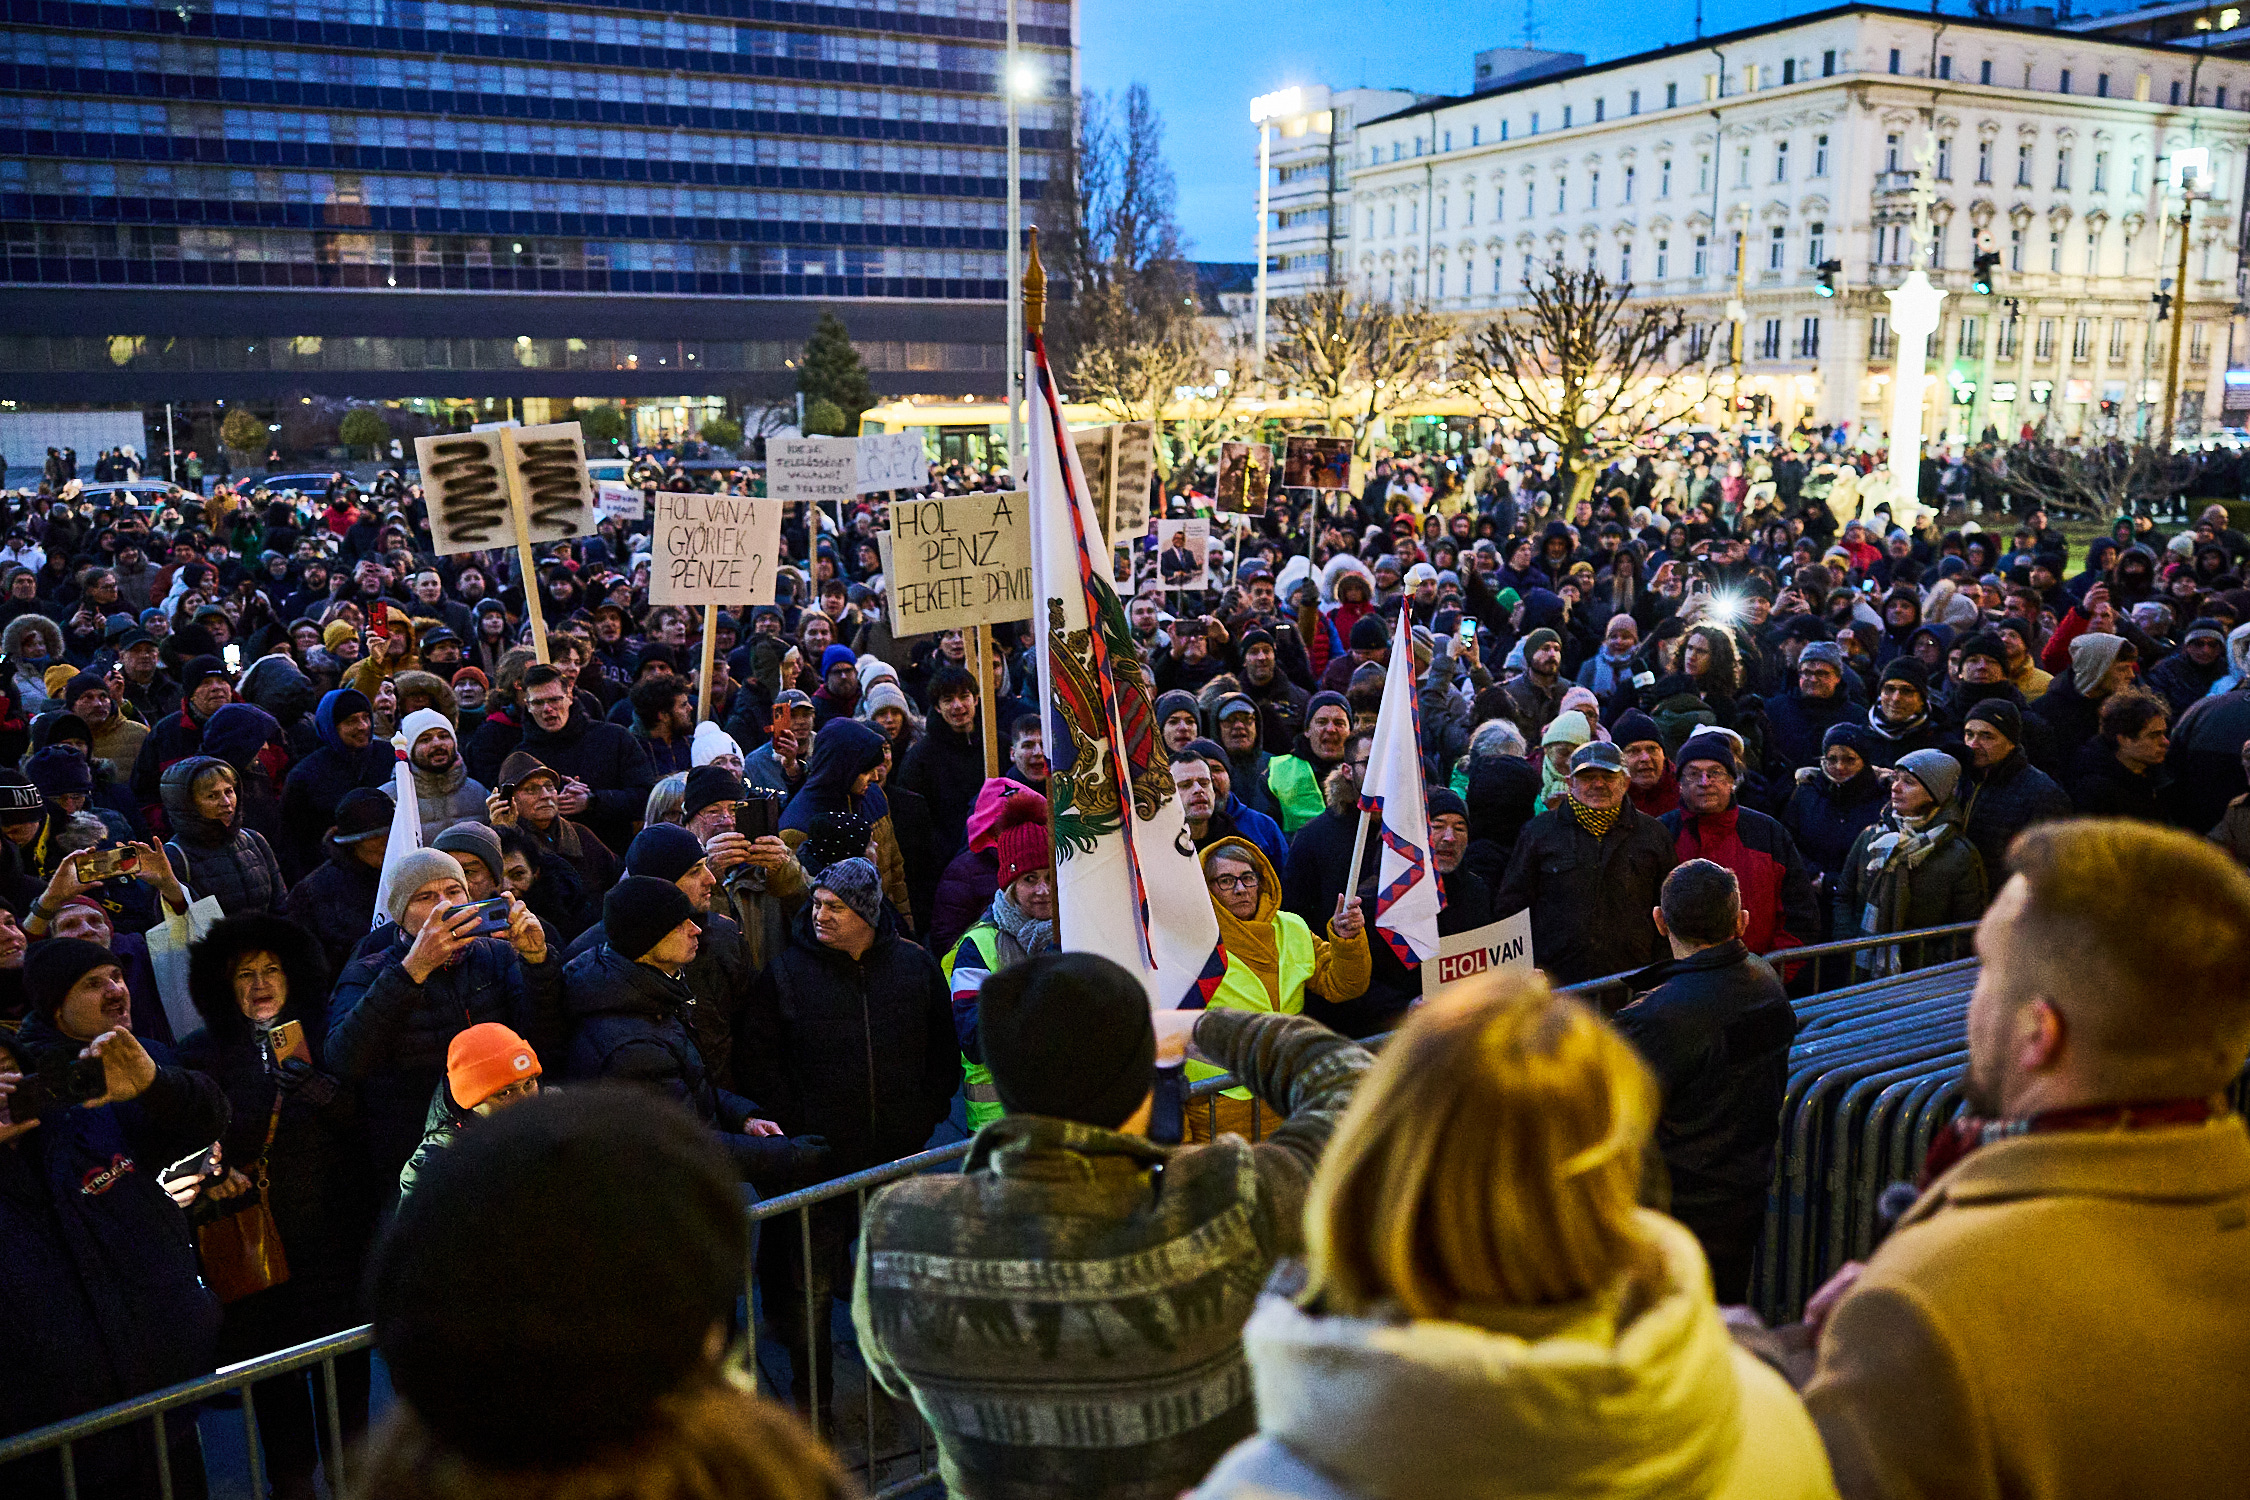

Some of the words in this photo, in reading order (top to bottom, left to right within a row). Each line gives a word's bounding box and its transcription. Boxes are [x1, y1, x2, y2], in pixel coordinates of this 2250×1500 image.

[659, 496, 698, 520] HOL
[705, 499, 740, 524] VAN
[741, 502, 755, 525] A
[896, 501, 957, 539] HOL
[992, 496, 1012, 526] A
[897, 576, 974, 616] FEKETE
[1441, 952, 1486, 981] HOL
[1488, 935, 1524, 967] VAN
